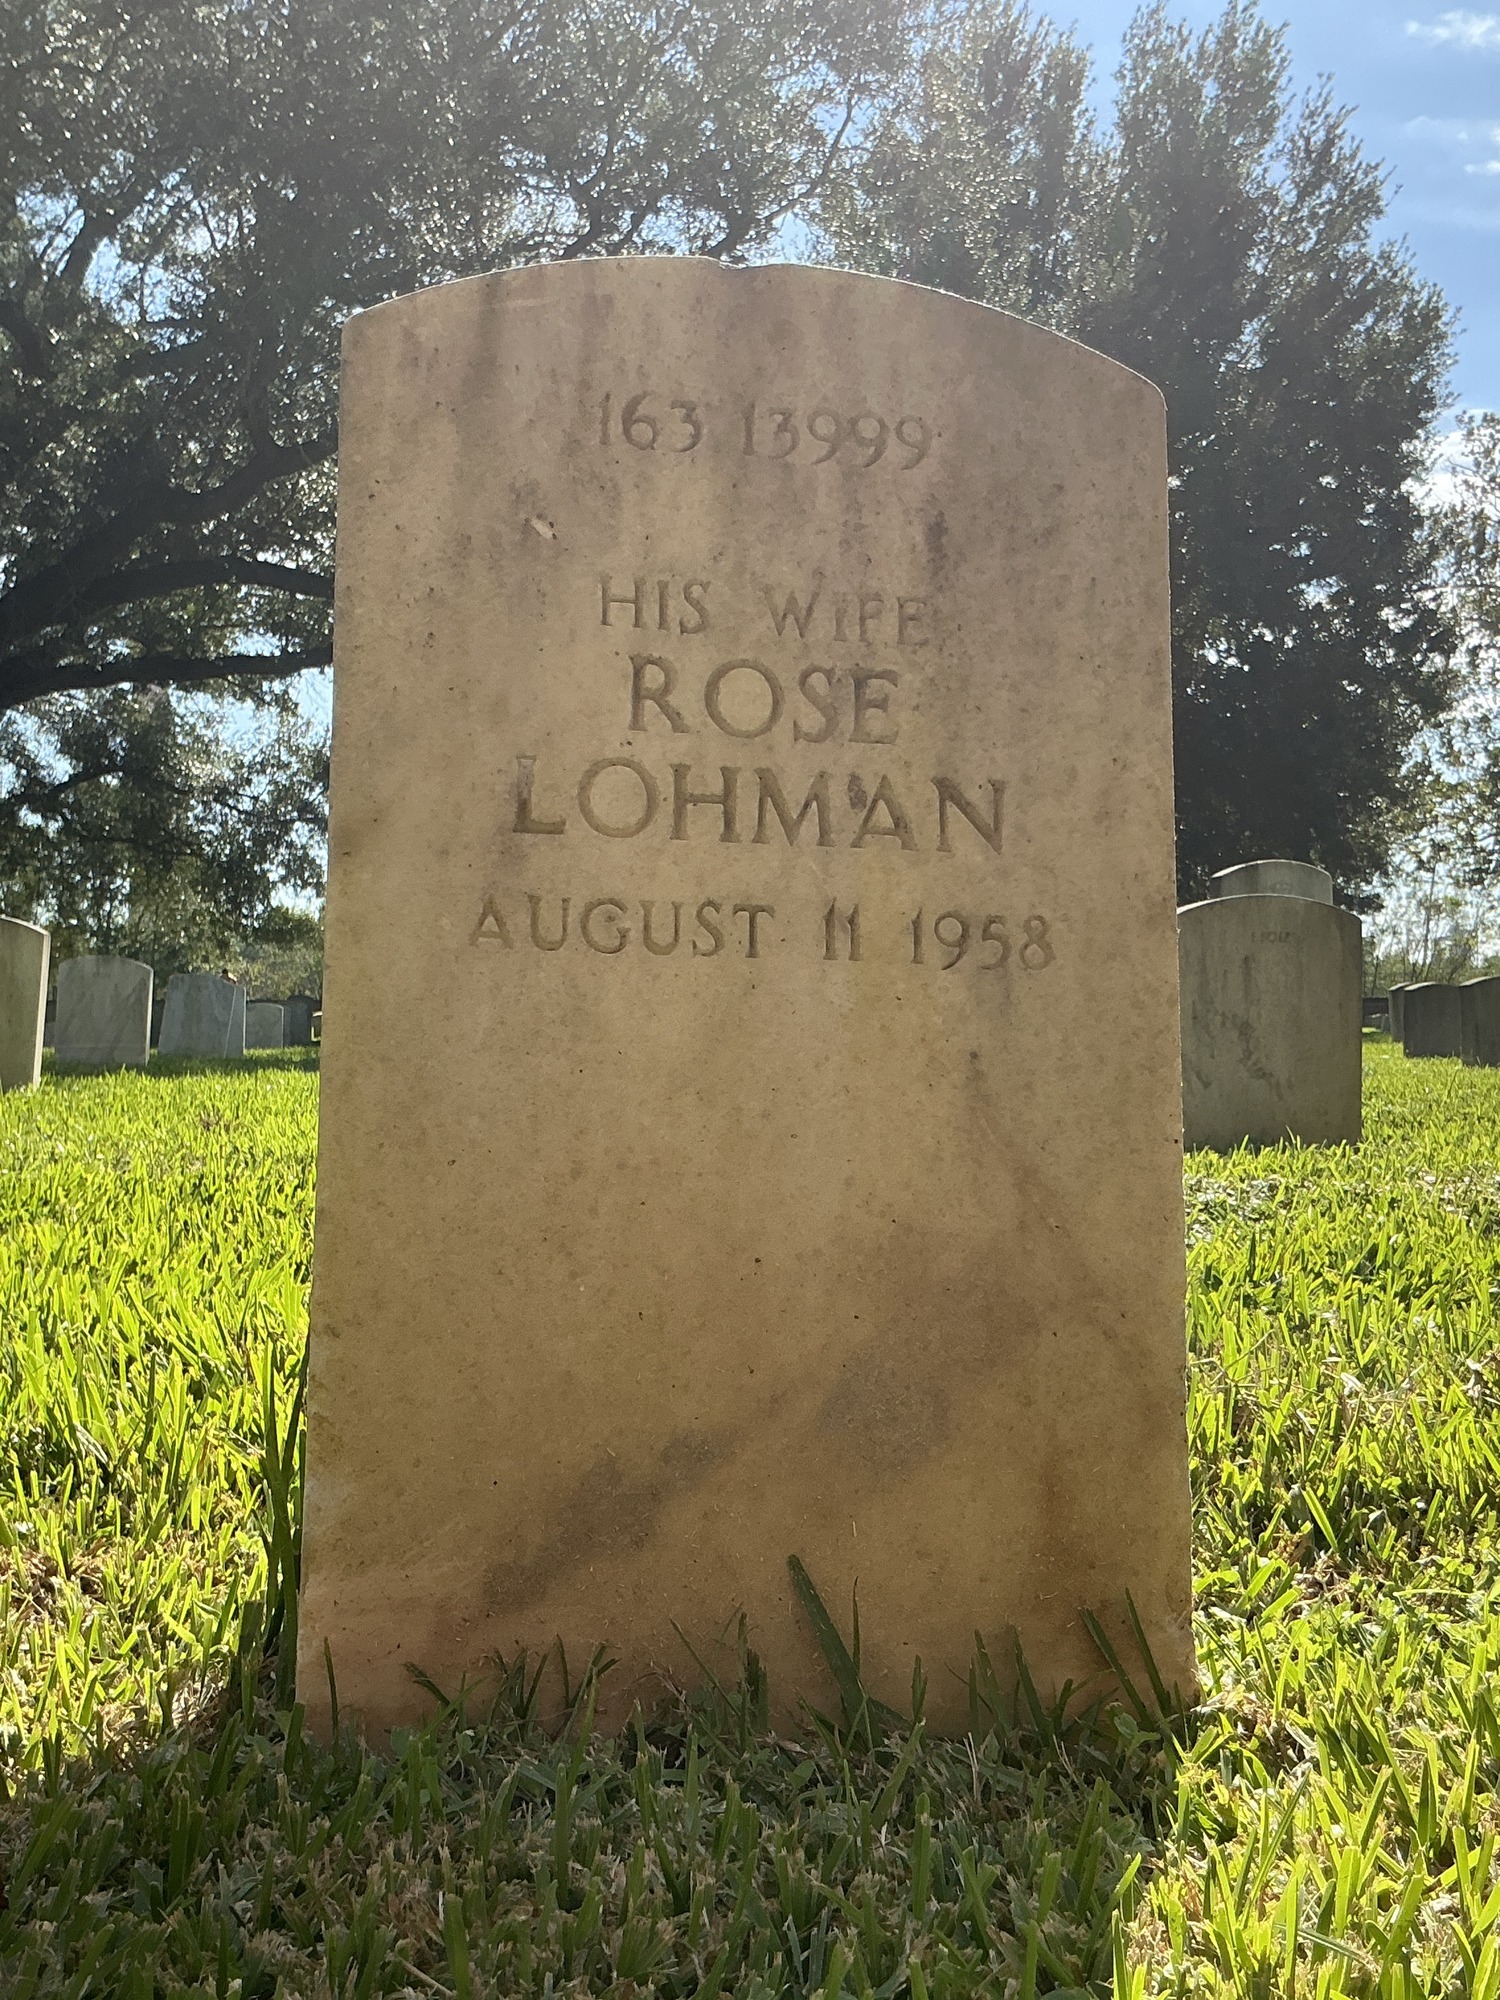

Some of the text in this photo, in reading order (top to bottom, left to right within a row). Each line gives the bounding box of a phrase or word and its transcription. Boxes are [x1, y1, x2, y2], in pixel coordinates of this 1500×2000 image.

[601, 391, 933, 471] 163 13999
[601, 575, 712, 636] HIS
[628, 653, 899, 744] ROSE
[512, 754, 1007, 855] LOHMAN
[469, 894, 1056, 971] AUGUST 11 1958
